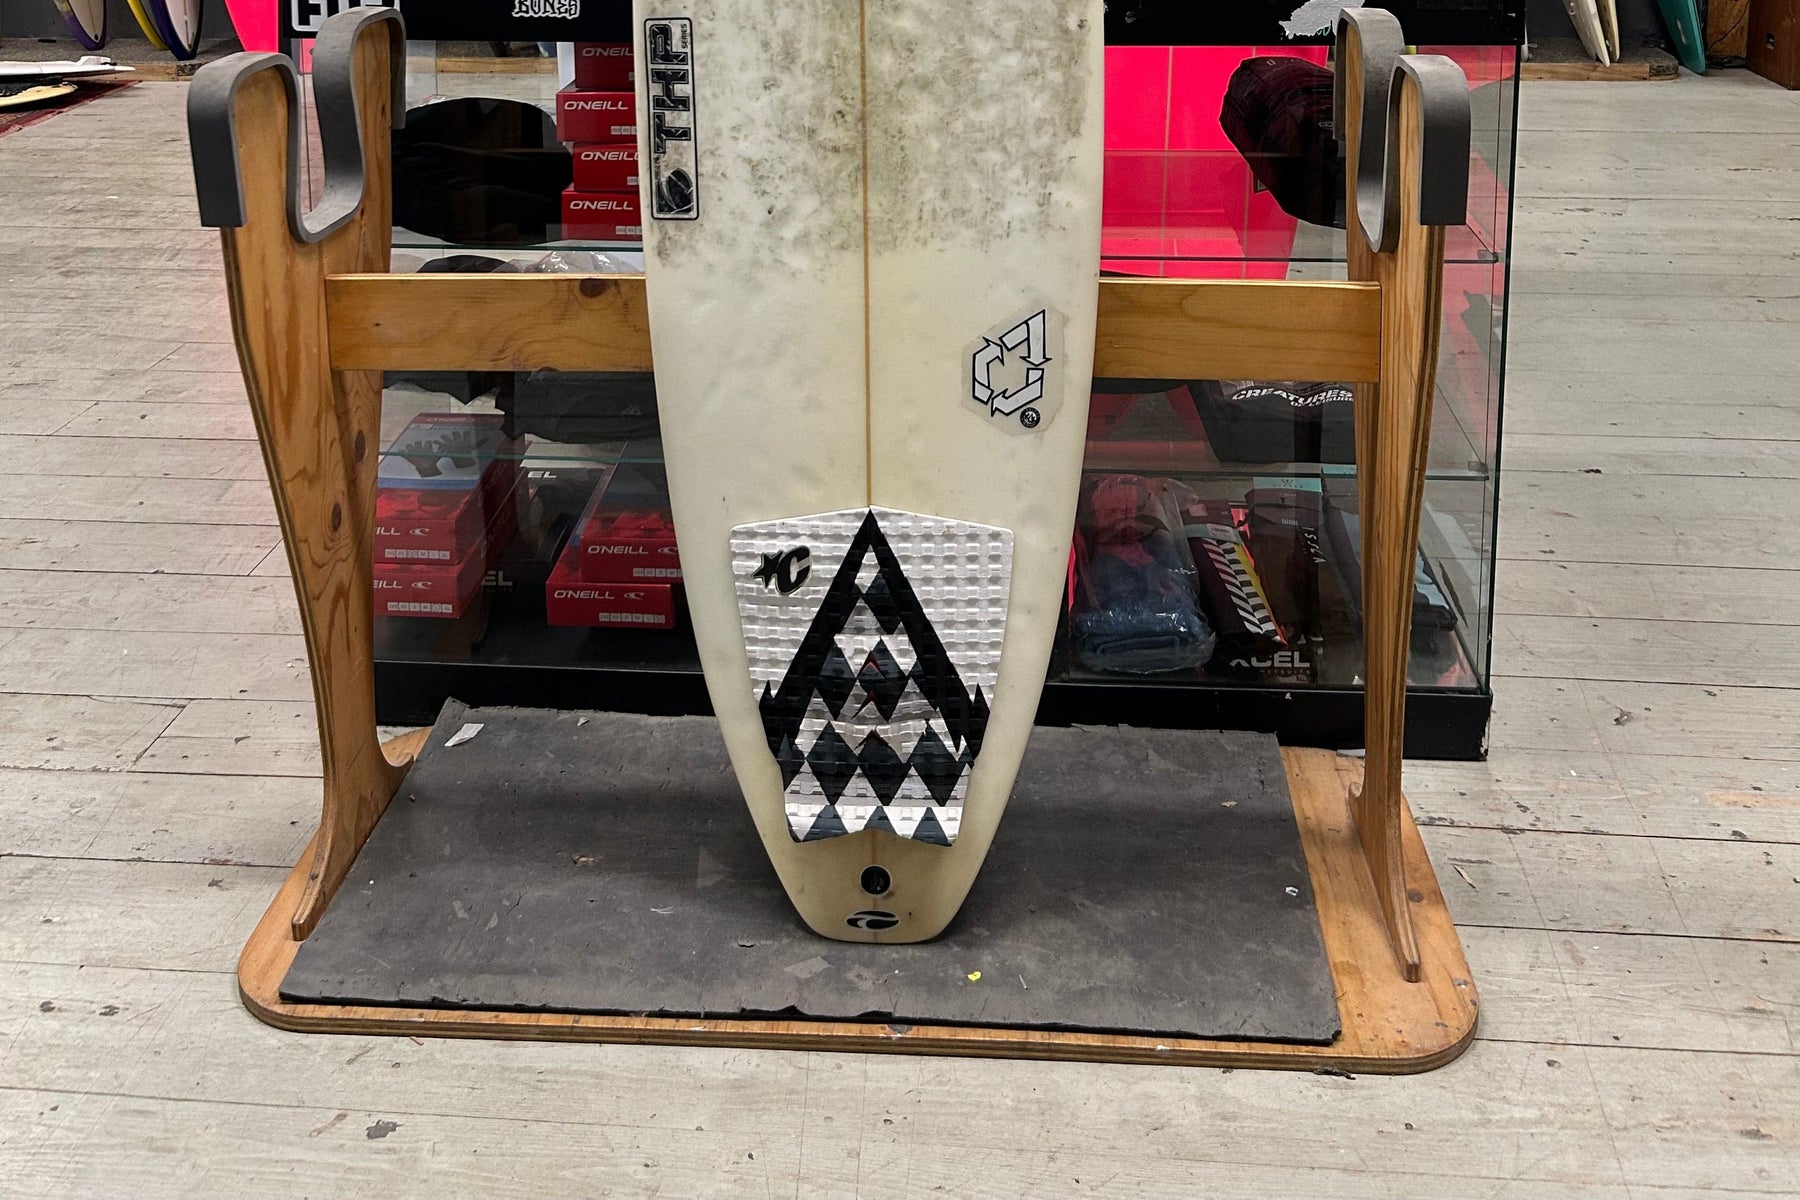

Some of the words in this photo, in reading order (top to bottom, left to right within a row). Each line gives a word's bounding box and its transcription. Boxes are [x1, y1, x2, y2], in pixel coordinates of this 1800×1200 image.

[680, 23, 688, 50] SERIES
[650, 24, 692, 154] THP
[564, 101, 629, 110] O'NEILL
[569, 200, 634, 210] O'NEILL
[1231, 388, 1354, 405] CREATURES
[587, 545, 648, 555] O'NEILL
[553, 590, 615, 600] O'NEILL
